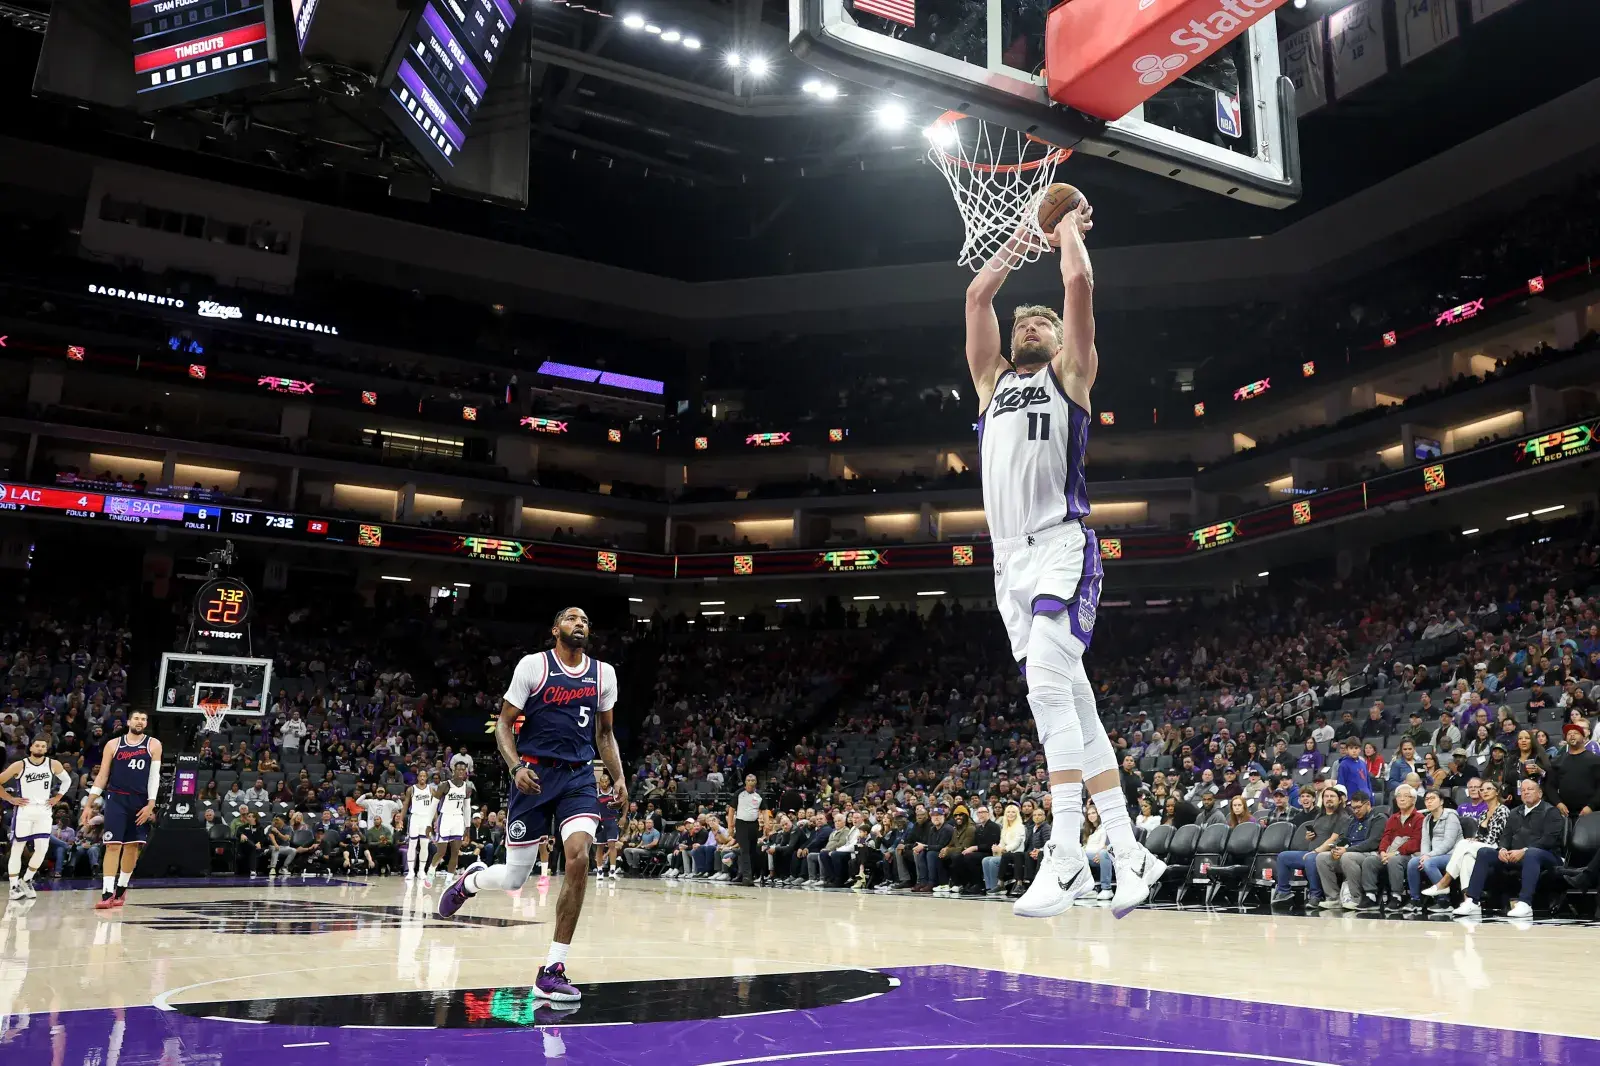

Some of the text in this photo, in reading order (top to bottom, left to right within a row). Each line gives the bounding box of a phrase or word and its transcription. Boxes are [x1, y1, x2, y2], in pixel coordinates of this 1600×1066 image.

[153, 0, 174, 13] TEAM
[175, 37, 224, 59] TIMEOUTS
[448, 38, 466, 65] FOULS
[420, 87, 447, 125] TIMEOUTS
[1220, 117, 1233, 131] NBA
[88, 284, 339, 335] SACRAMENTO Kings BASKETBALL
[1436, 298, 1484, 326] APEX
[258, 376, 315, 394] APEX
[1234, 377, 1270, 400] APEX
[520, 416, 568, 433] APEX
[1027, 412, 1051, 441] 11
[746, 432, 790, 446] APEX
[1544, 452, 1562, 462] RED
[1564, 445, 1590, 457] HAWK
[10, 488, 88, 507] LAC 4
[65, 509, 88, 517] FOULS
[108, 513, 141, 523] TIMEOUTS
[132, 501, 161, 514] SAC
[197, 508, 207, 519] 6
[184, 521, 205, 530] FOULS
[230, 512, 322, 531] 1ST 7:32 22
[1190, 520, 1242, 545] APEX
[458, 536, 532, 559] APEX
[498, 555, 521, 563] HAWK
[820, 549, 888, 566] APEX
[216, 588, 244, 603] 7:32
[206, 600, 239, 624] 22
[210, 630, 242, 640] TISSOT
[543, 685, 597, 706] Clippers
[577, 705, 591, 728] 5
[116, 749, 147, 761] Clippers
[127, 758, 146, 770] 40
